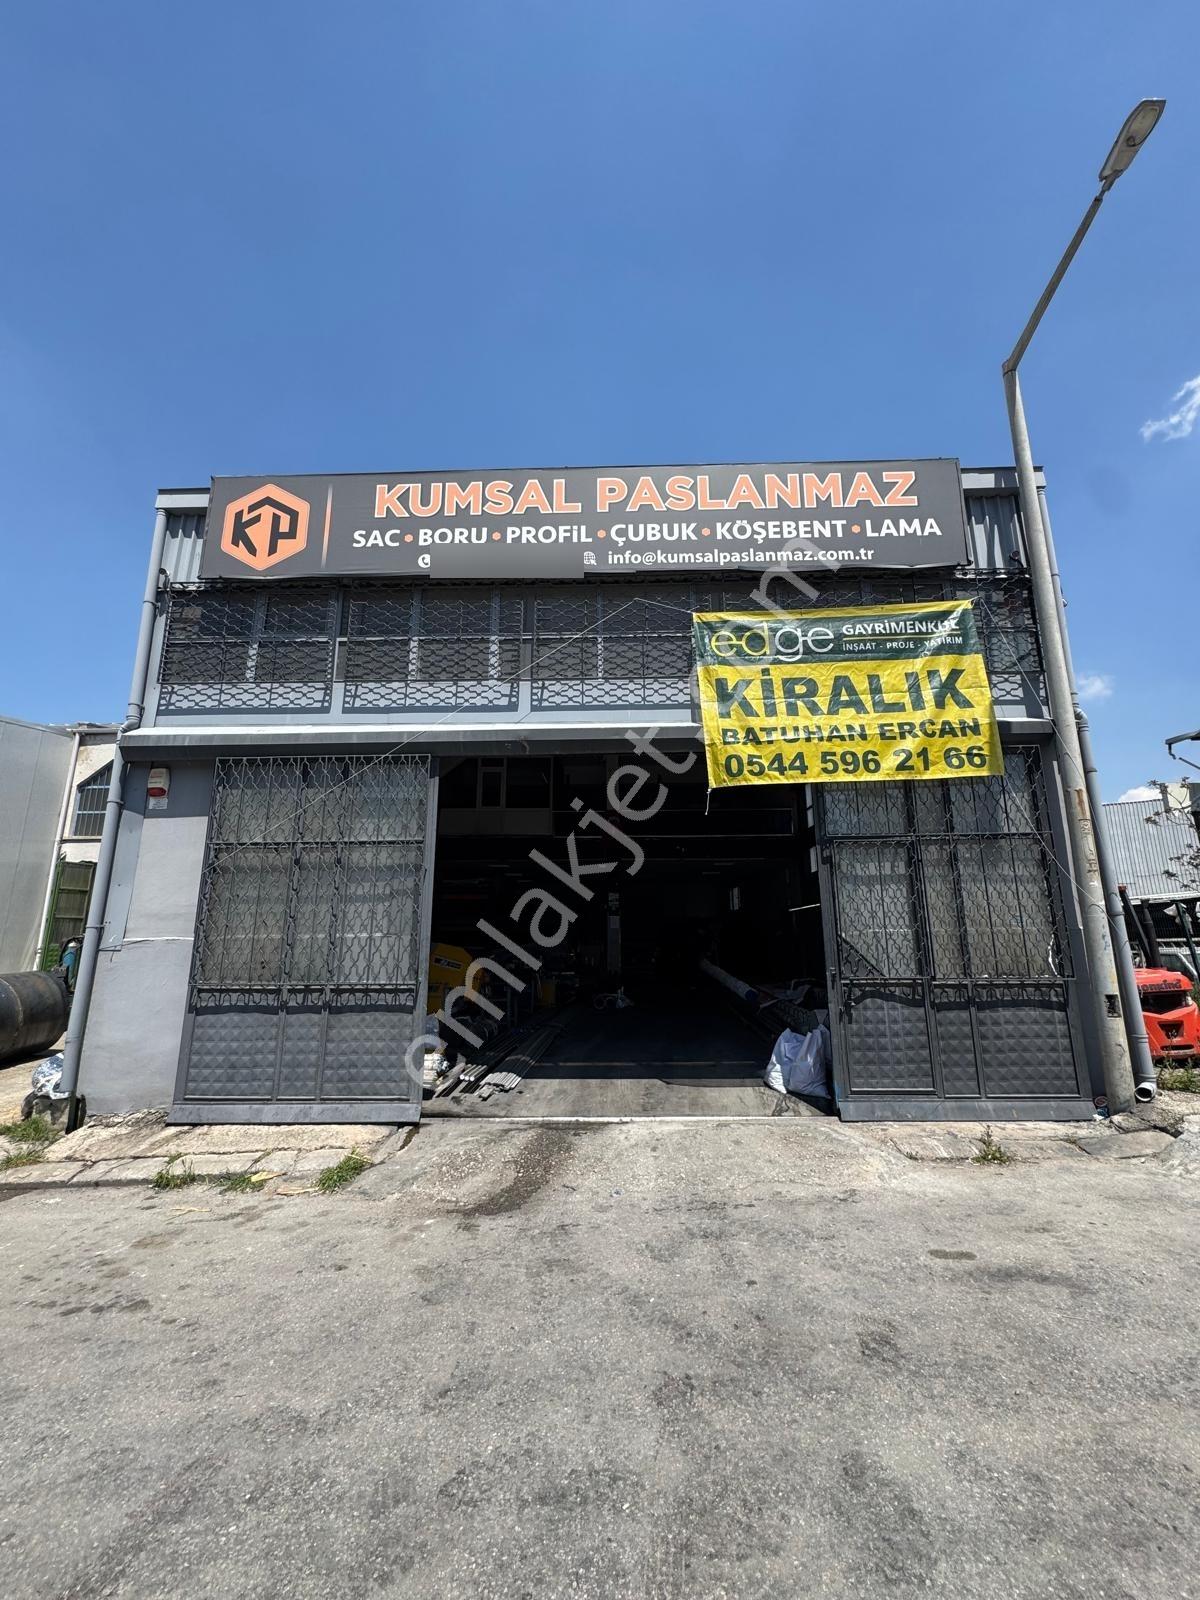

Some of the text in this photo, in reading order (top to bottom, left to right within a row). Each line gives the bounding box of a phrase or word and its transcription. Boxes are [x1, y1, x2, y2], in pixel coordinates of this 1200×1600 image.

[374, 471, 918, 518] KUMSAL PASLANMAZ
[353, 529, 400, 548] SAC
[418, 526, 488, 546] BORU
[610, 522, 699, 547] ÇUBUK
[715, 519, 847, 544] KÖŞEBENT
[865, 518, 942, 538] LAMA
[608, 547, 875, 566] info@kumsalpaslanmaz.com.tr
[711, 621, 834, 662] edge
[842, 642, 877, 652] İNŞAAT
[886, 641, 915, 649] PROJE
[714, 668, 976, 719] KİRALIK
[722, 718, 982, 745] BATUHAN ERCAN
[724, 745, 987, 777] 0544 596 21 66
